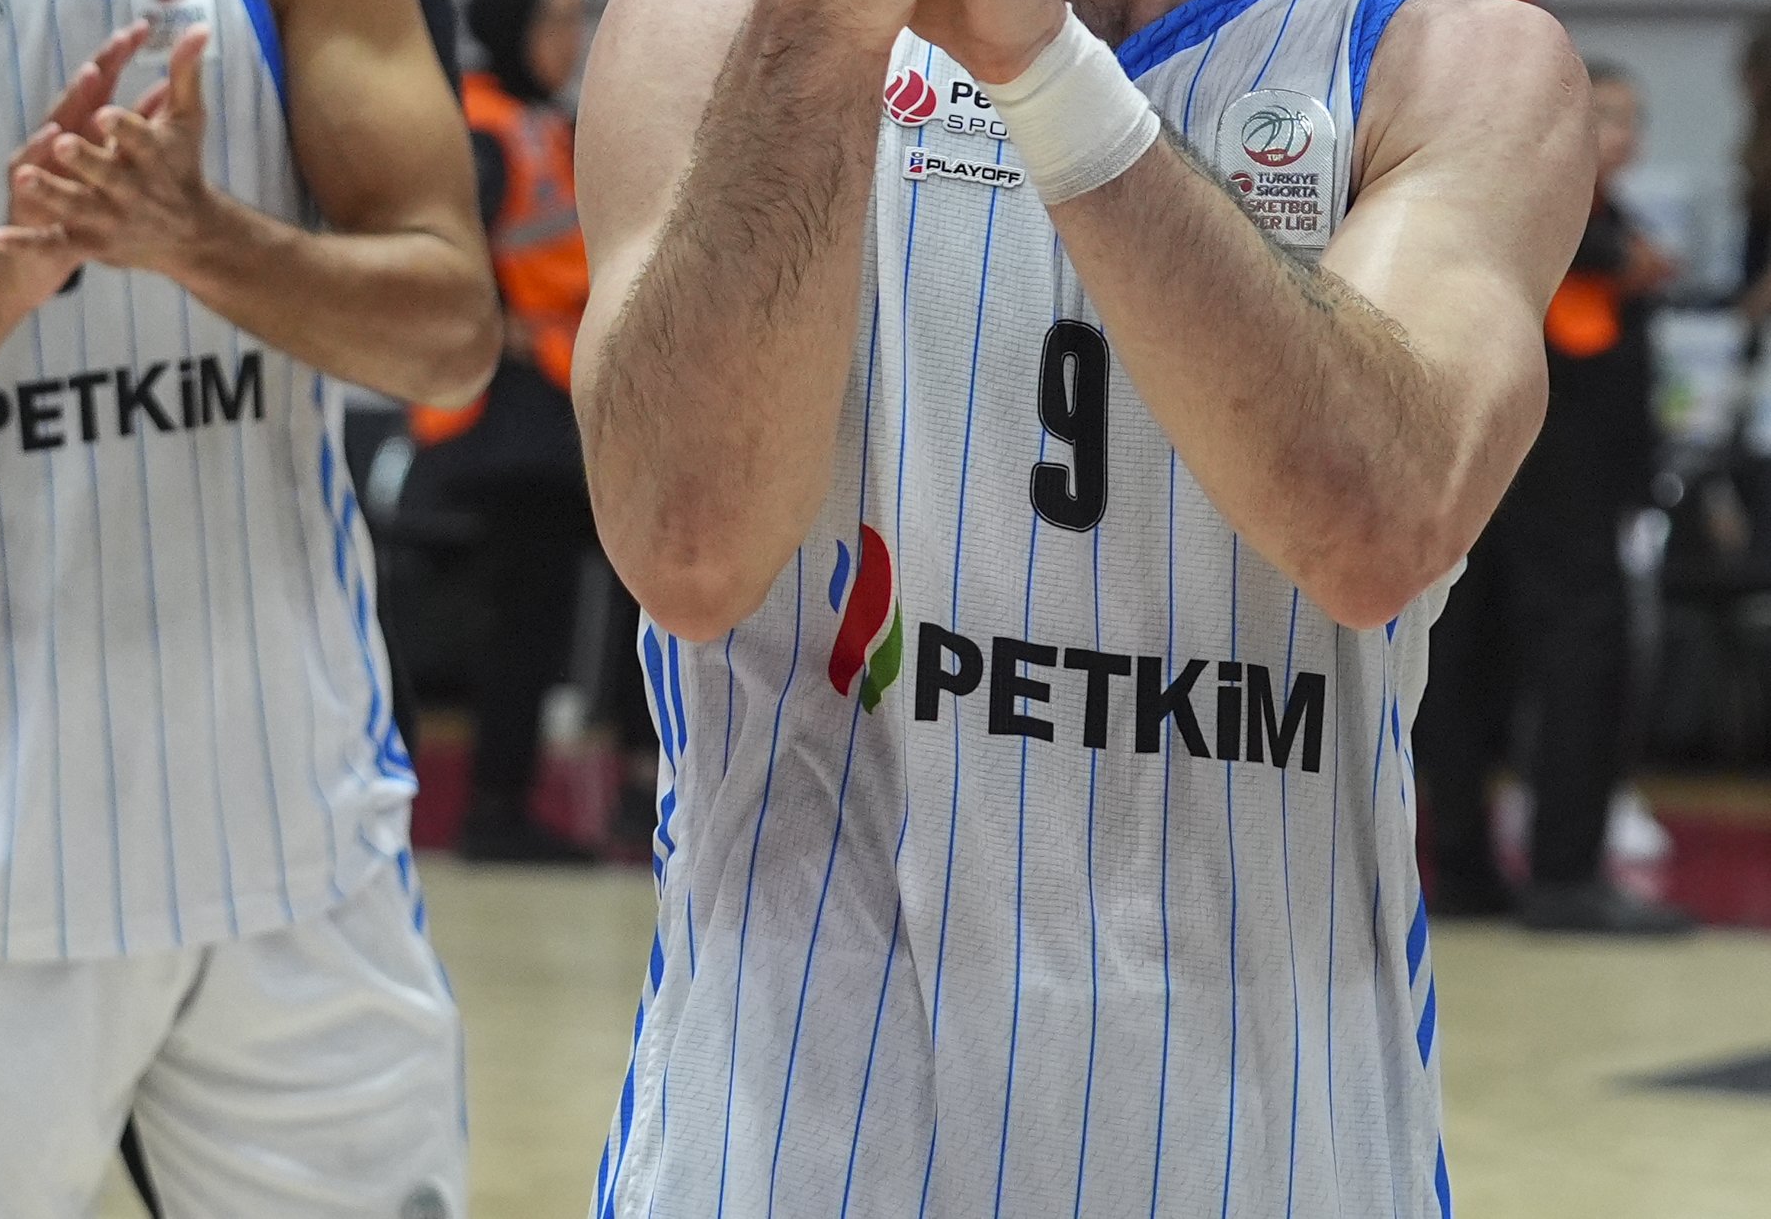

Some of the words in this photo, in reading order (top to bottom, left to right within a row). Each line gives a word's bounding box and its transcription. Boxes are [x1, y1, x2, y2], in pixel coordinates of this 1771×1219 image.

[947, 114, 1008, 137] SPO
[926, 158, 1021, 184] PLAYOFF
[1248, 199, 1324, 215] SKETBOL
[1030, 319, 1110, 533] 9
